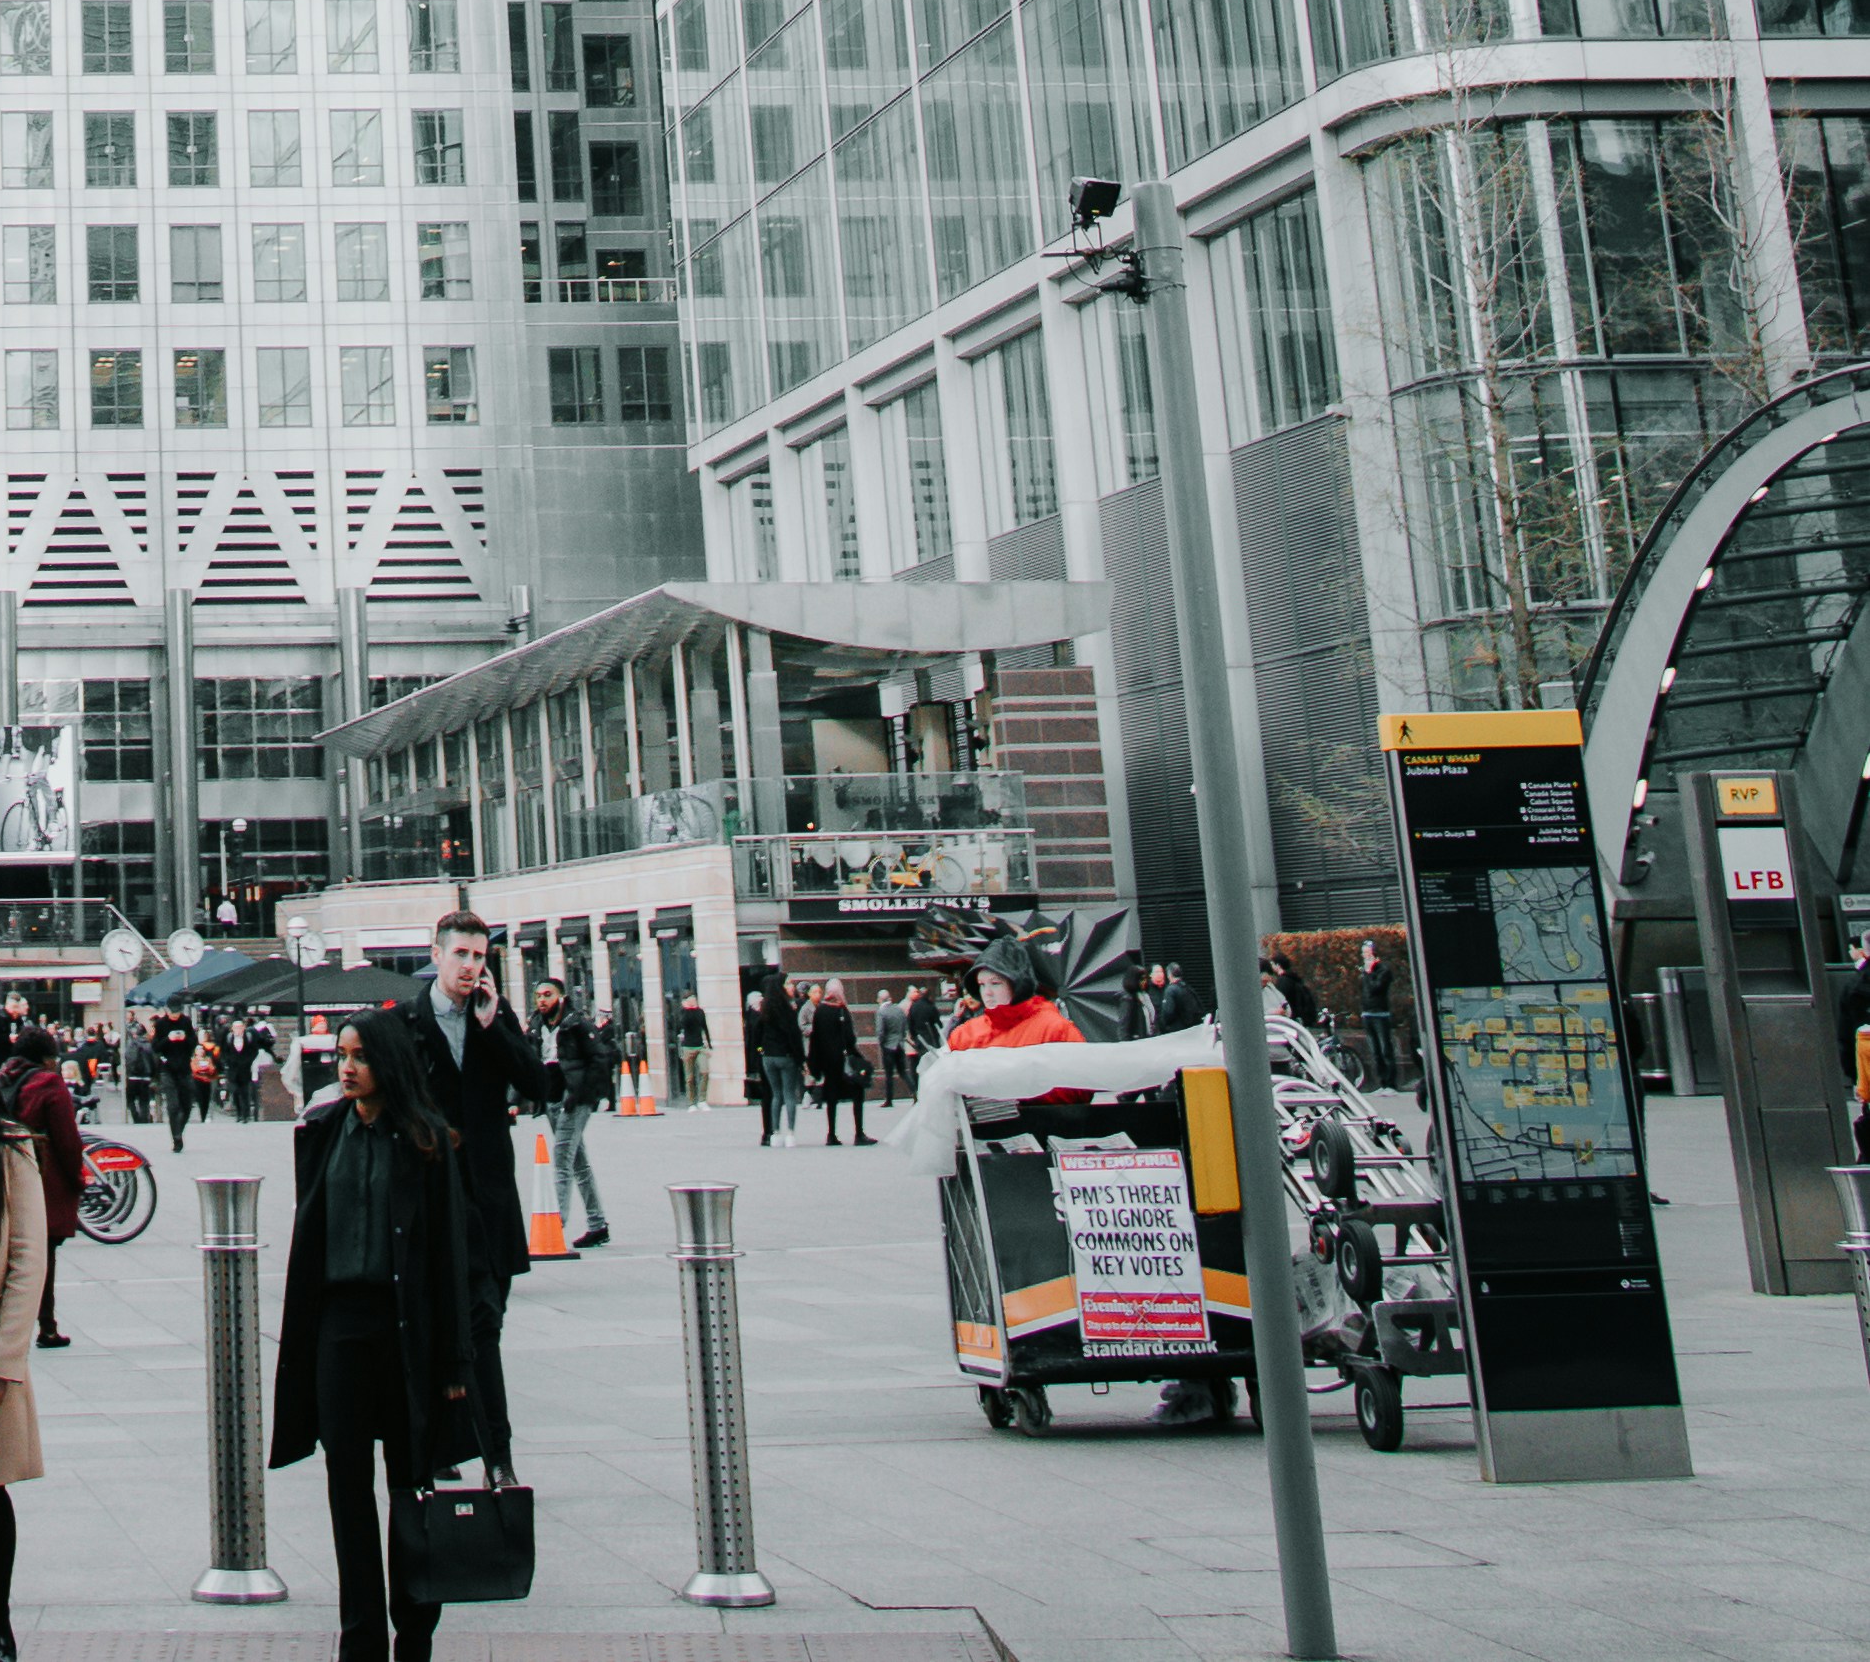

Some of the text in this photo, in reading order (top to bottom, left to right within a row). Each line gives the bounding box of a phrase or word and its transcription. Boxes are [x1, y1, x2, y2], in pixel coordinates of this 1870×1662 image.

[1403, 753, 1481, 765] CANARY WHARF
[1405, 765, 1469, 775] Jubilee Plaza
[1730, 788, 1759, 801] RVP
[1734, 871, 1785, 890] LFB
[1062, 1155, 1178, 1168] WEST END FINAL
[1069, 1184, 1182, 1206] PM'S THREAT
[1085, 1208, 1178, 1228] TO IGNORE
[1074, 1232, 1195, 1252] COMMONS ON
[1091, 1255, 1184, 1276] KEY VOTES
[1083, 1298, 1200, 1316] Evening Standard
[1082, 1339, 1219, 1358] standard.co.uk
